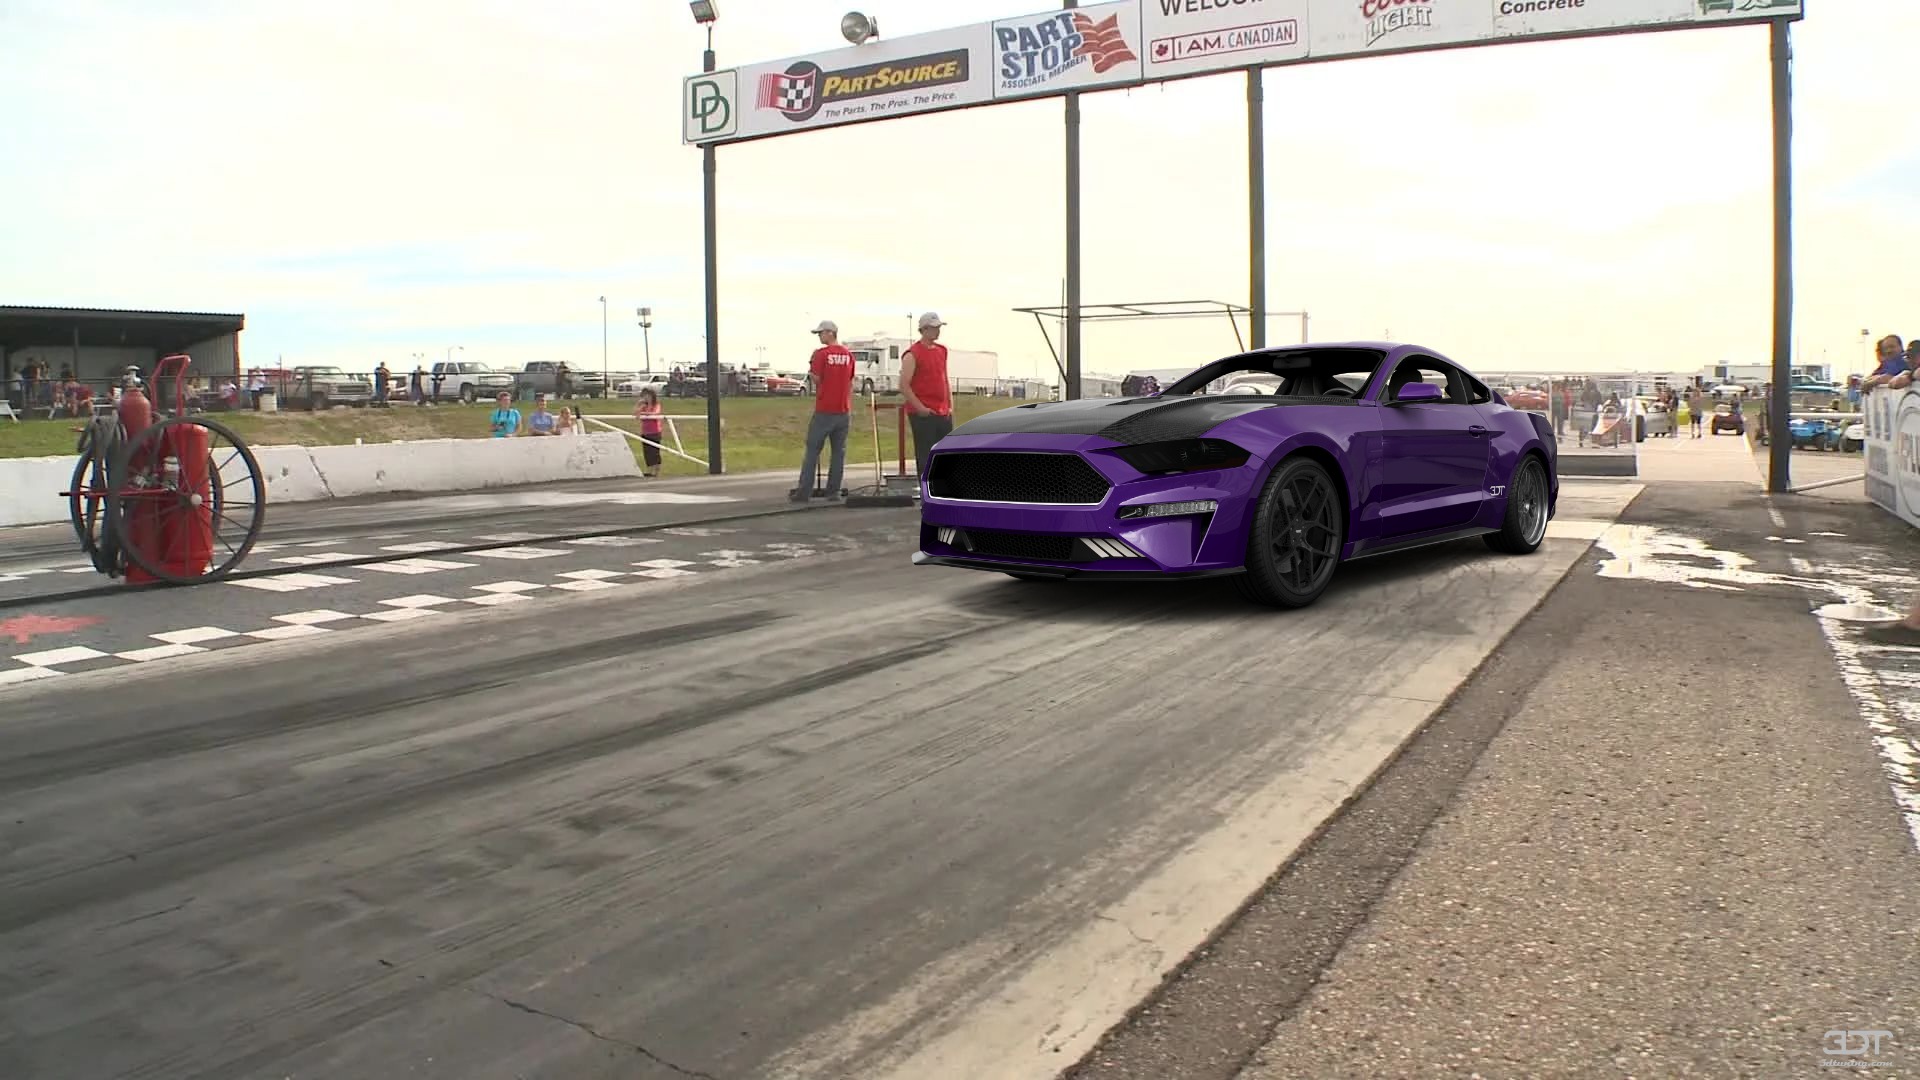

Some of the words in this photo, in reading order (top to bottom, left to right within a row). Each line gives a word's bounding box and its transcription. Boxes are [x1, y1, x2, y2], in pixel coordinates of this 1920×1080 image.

[1500, 0, 1585, 15] Concrete
[995, 13, 1074, 51] PART
[1177, 41, 1182, 55] I
[1186, 36, 1225, 53] AM.
[1227, 23, 1293, 49] CANADIAN
[1366, 6, 1432, 47] LIGHT
[1001, 33, 1082, 80] STOP
[1001, 75, 1047, 89] ASSOCIATE
[1048, 55, 1088, 80] MEMBER
[824, 109, 841, 118] The
[870, 102, 886, 112] The
[913, 96, 930, 105] The
